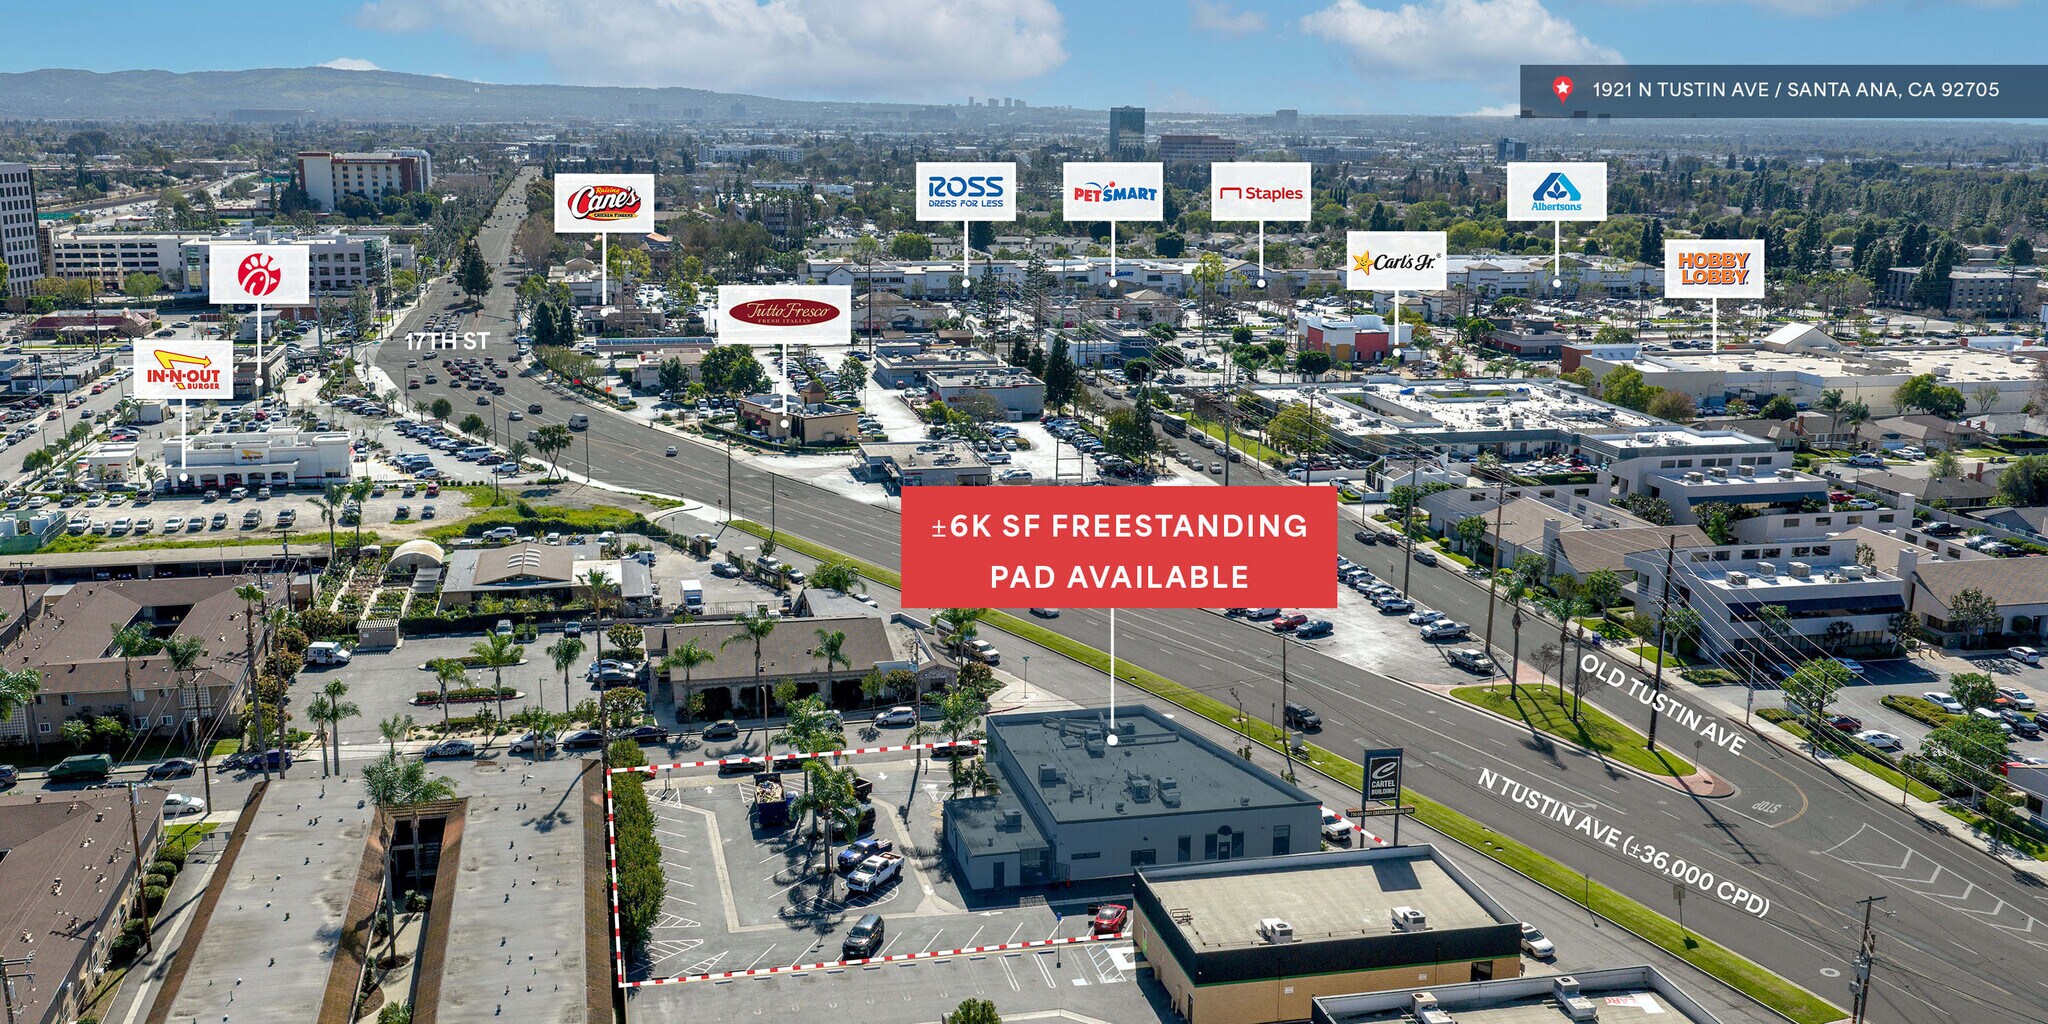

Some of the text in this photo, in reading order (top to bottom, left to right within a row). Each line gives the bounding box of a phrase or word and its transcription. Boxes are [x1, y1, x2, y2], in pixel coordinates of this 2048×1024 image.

[1371, 780, 1396, 788] CARTEL
[1371, 788, 1396, 796] BUILDING
[1751, 800, 1782, 814] STOP
